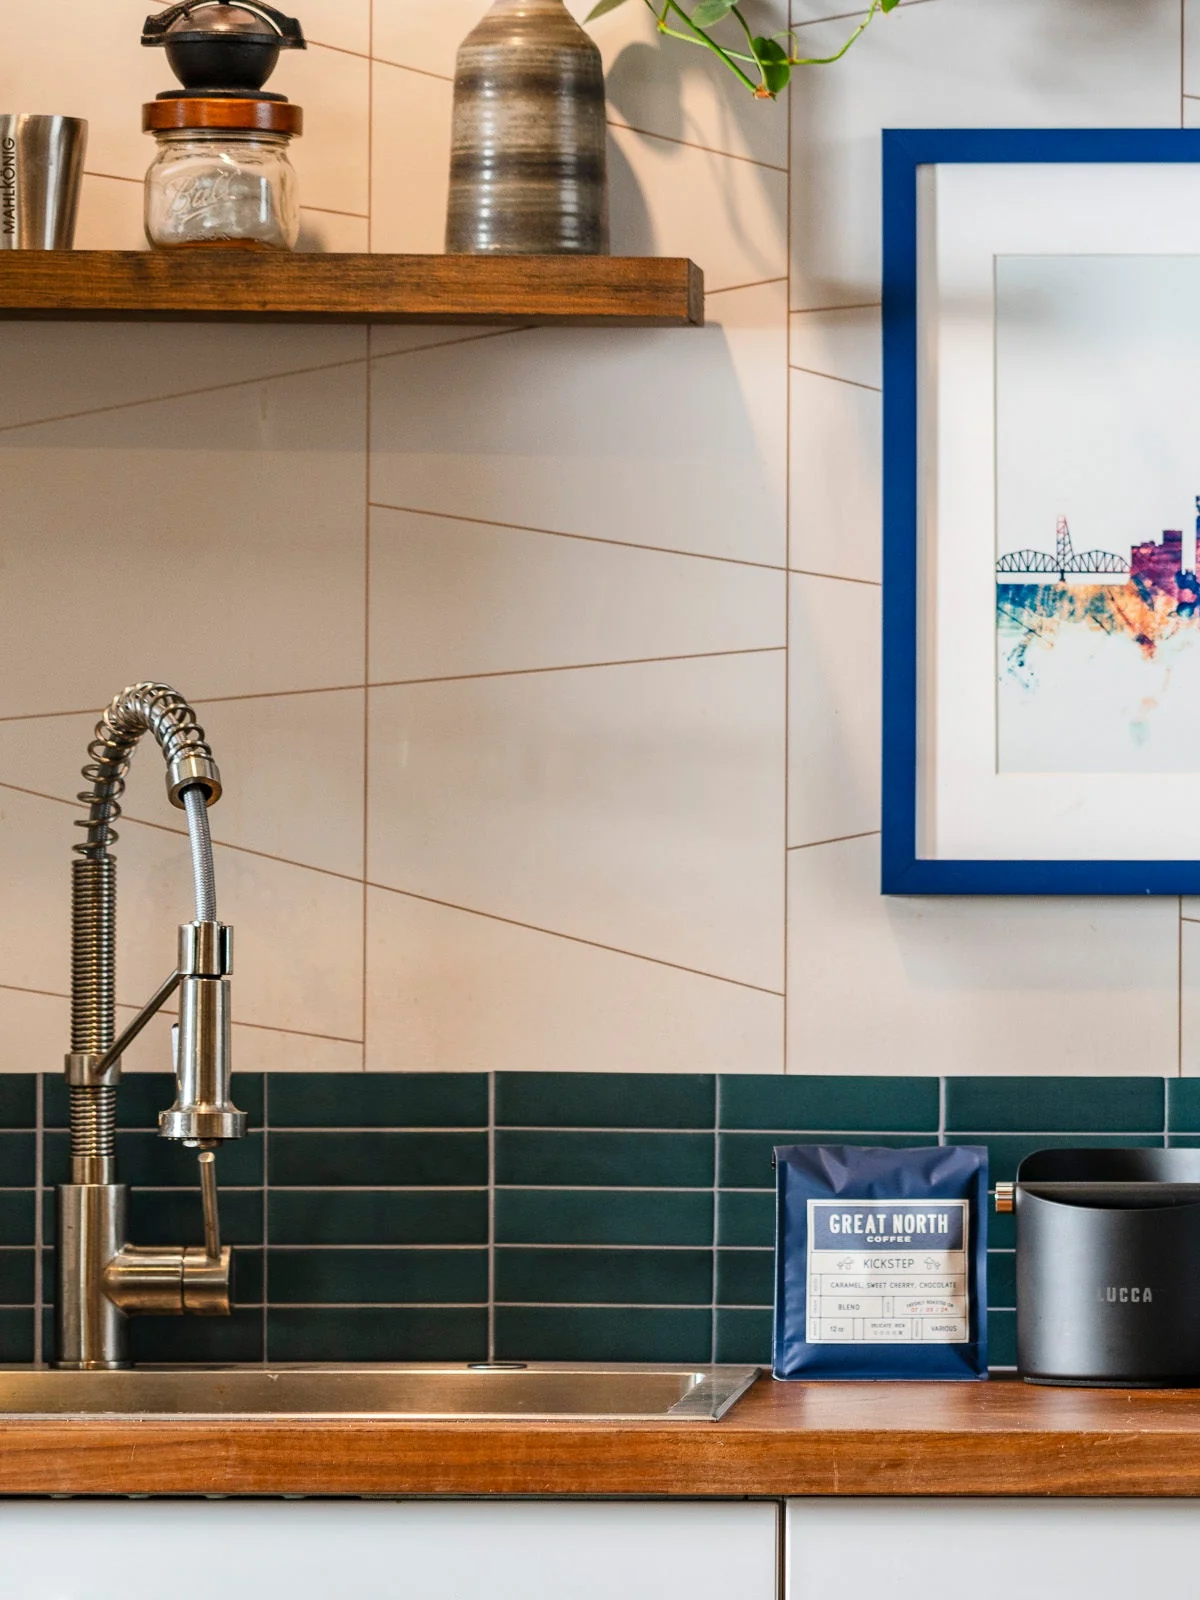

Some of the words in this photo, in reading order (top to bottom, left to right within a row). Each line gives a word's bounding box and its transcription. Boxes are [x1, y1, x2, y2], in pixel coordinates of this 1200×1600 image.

[829, 1214, 887, 1234] GREAT
[892, 1214, 949, 1234] NORTH
[863, 1258, 915, 1269] KICKSTEP
[919, 1281, 957, 1289] CHOCOLATE
[838, 1303, 861, 1311] BLEND
